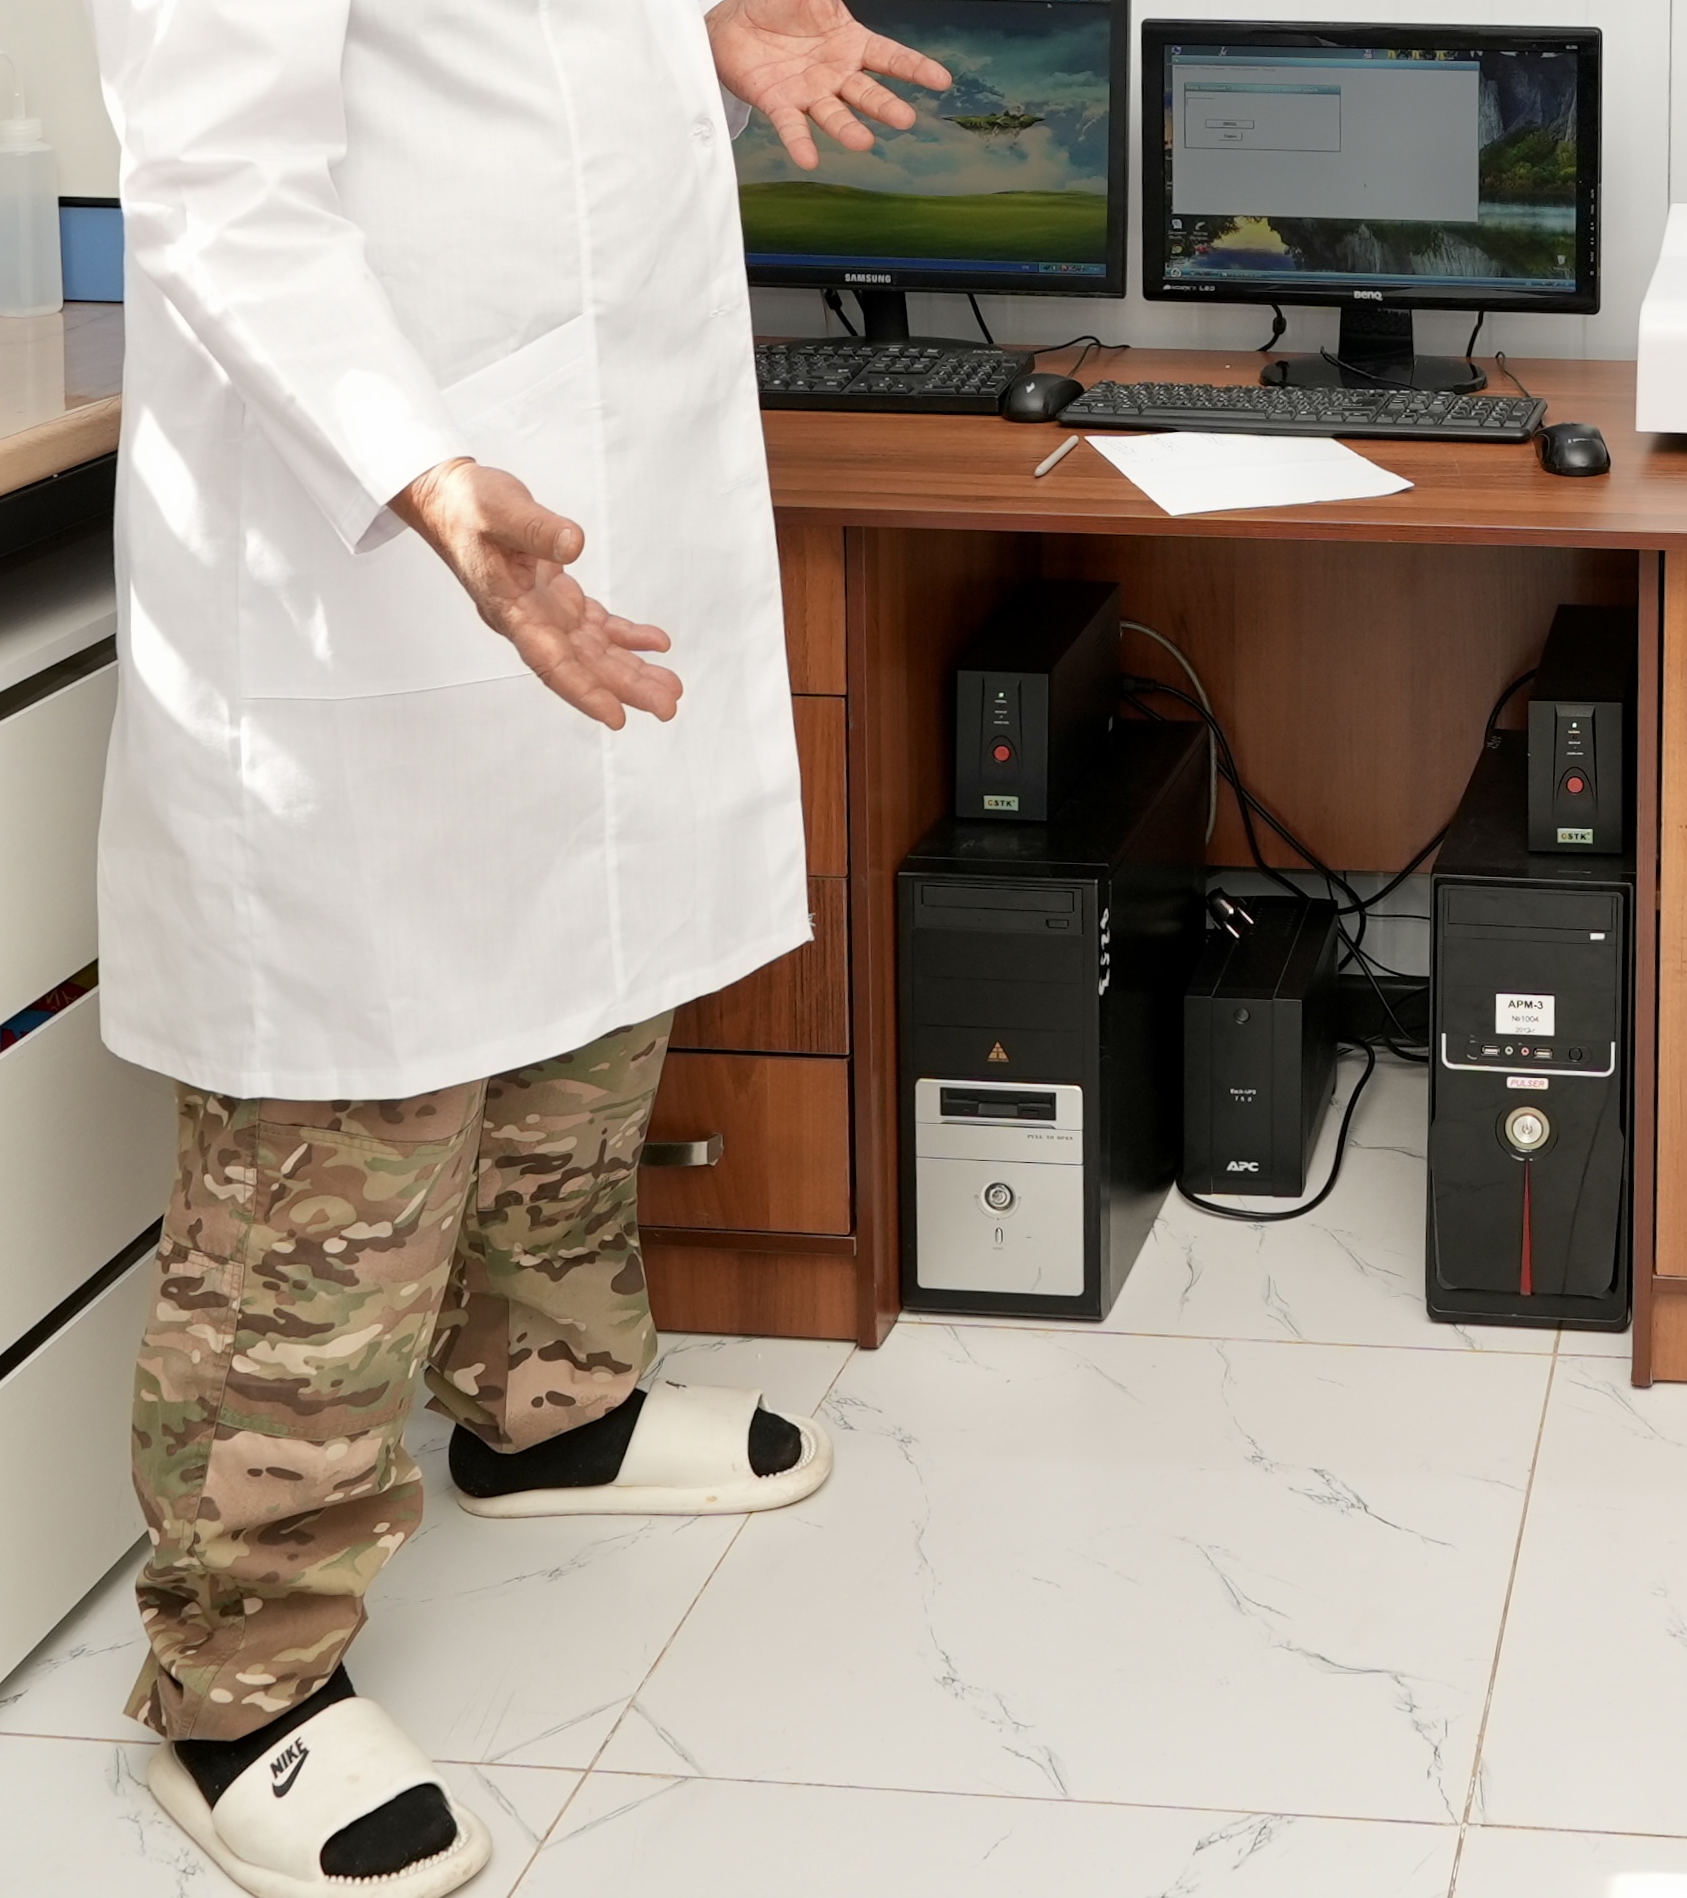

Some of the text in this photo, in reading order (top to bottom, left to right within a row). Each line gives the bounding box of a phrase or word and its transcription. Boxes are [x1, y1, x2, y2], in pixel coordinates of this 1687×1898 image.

[844, 272, 892, 284] SAMSUNG
[1509, 1079, 1546, 1088] PULSER
[1226, 1160, 1260, 1172] APC
[268, 1735, 310, 1779] NIKE
